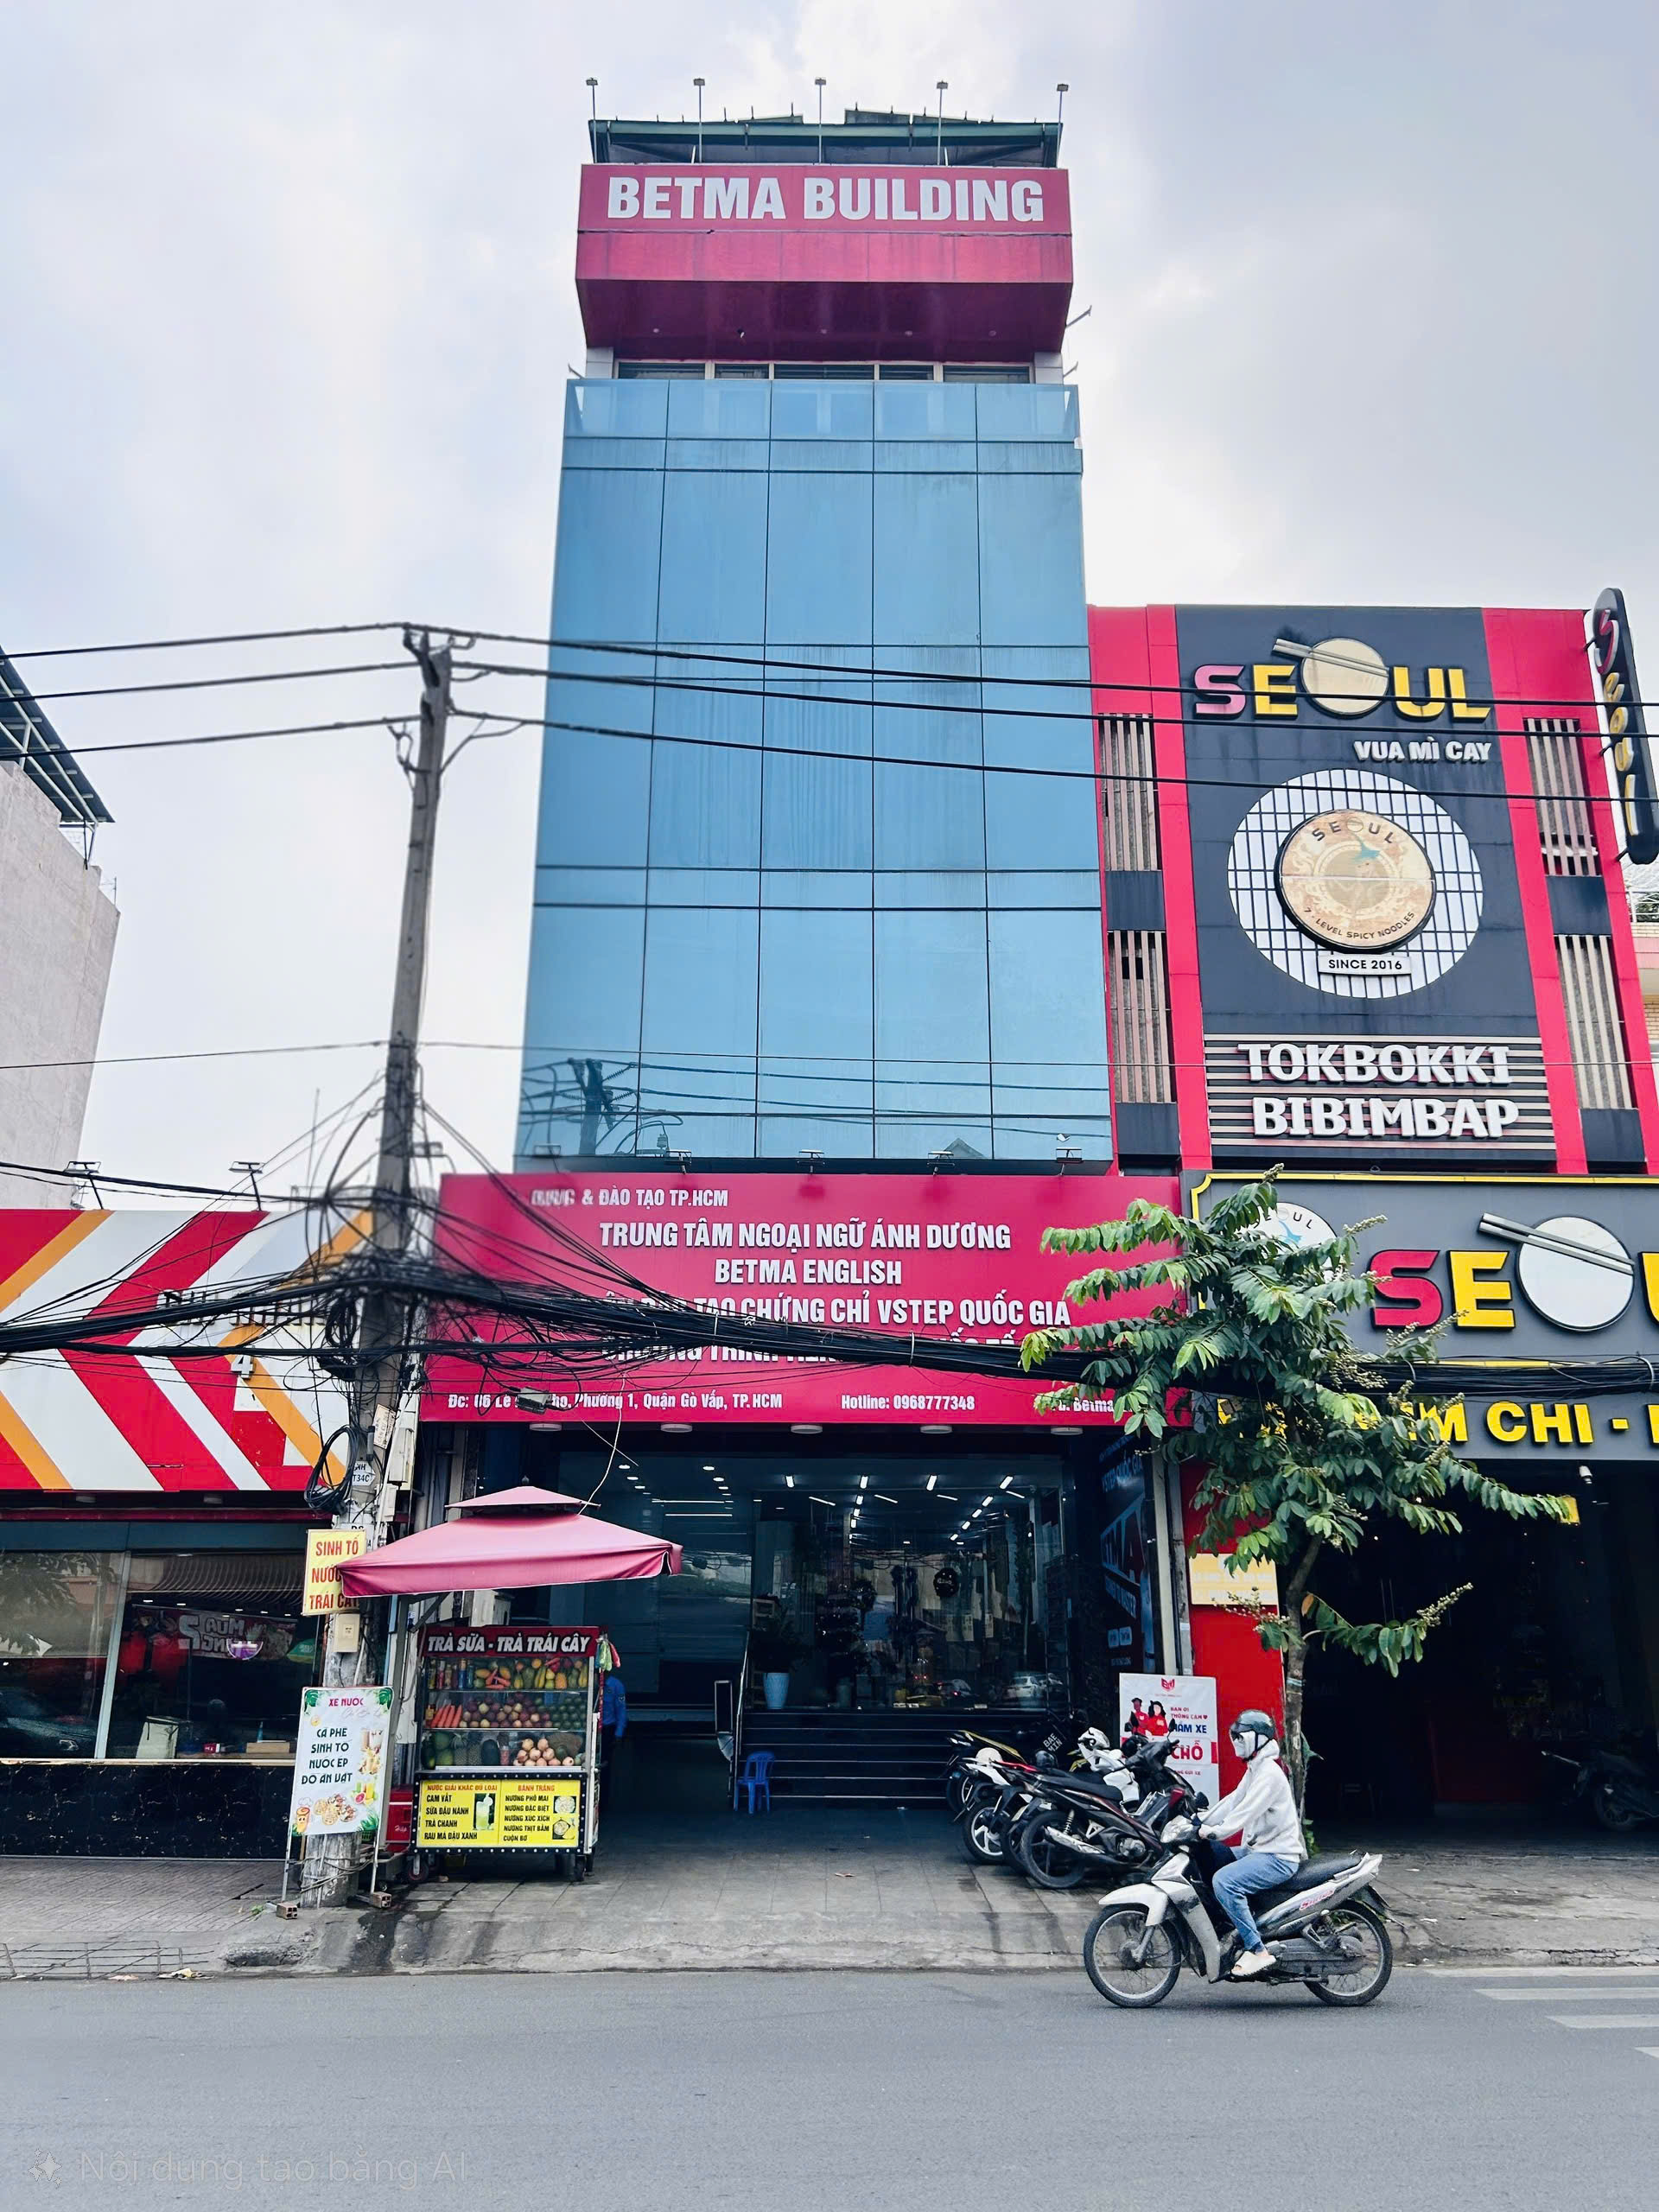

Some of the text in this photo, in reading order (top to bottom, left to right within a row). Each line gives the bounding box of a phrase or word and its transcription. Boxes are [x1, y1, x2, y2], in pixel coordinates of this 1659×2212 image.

[607, 177, 1044, 222] BETMA BUILDING
[1194, 638, 1491, 721] SEOUL
[1354, 736, 1491, 762] VUA MÌ CAY
[1312, 817, 1395, 844] SEOUL
[1315, 918, 1343, 936] LEVEL
[1346, 931, 1376, 940] SPICY
[1378, 912, 1415, 938] NOODLES
[1328, 959, 1402, 969] SINCE 2016
[1237, 1043, 1512, 1084] TOKBOKKI
[1253, 1096, 1519, 1138] BIBIMBAP
[582, 1188, 594, 1205] &
[599, 1185, 631, 1206] ĐÀO
[635, 1189, 665, 1210] TẠO
[670, 1189, 728, 1207] TP.HCM
[599, 1217, 1011, 1253] TRUNG TÂM NGOẠI NGỮ ÁNH DƯƠNG
[715, 1258, 902, 1284] BETMA ENGLISH
[741, 1293, 825, 1323] CHỨNG
[835, 1289, 869, 1324] CHỈ
[877, 1299, 954, 1325] VSTEP
[959, 1289, 1024, 1326] QUỐC
[1029, 1300, 1071, 1326] GIA
[627, 1393, 638, 1410] 1,
[643, 1392, 675, 1410] Quận
[681, 1392, 697, 1408] Gò
[701, 1389, 728, 1411] Vấp,
[841, 1394, 975, 1410] Hotline: 0968777348
[1486, 1401, 1593, 1444] CHI
[315, 1540, 342, 1556] SINH
[346, 1535, 360, 1554] TỐ
[309, 1590, 334, 1609] TRÁI
[428, 1632, 454, 1652] TRÀ
[456, 1632, 485, 1652] SỮA
[497, 1632, 523, 1652] TRÀ
[526, 1631, 559, 1652] TRÁI
[562, 1631, 591, 1652] CÂY
[1196, 1724, 1207, 1733] XE
[311, 1743, 333, 1753] SINH
[437, 1819, 458, 1827] CHANH
